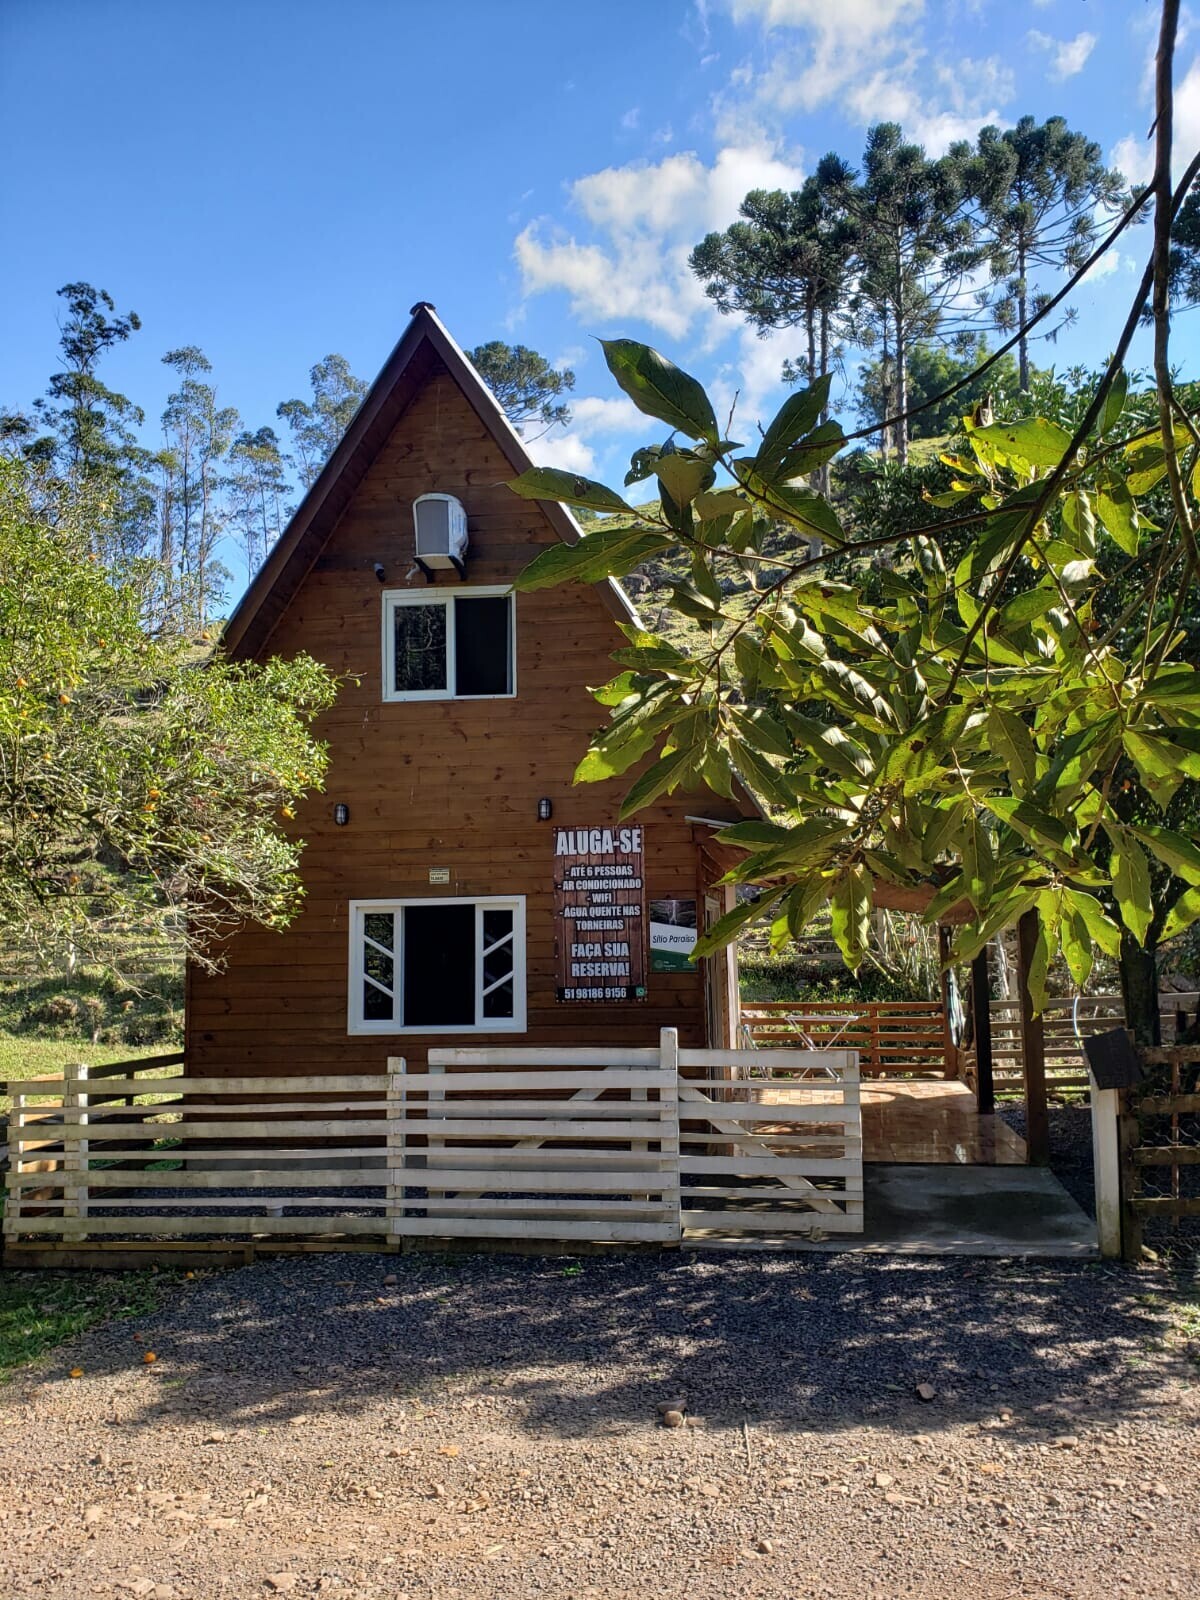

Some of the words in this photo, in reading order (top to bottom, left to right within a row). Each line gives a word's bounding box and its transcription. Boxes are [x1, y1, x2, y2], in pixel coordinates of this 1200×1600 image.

[556, 829, 641, 856] ALUGA-SE
[570, 865, 586, 877] ATÉ
[587, 866, 593, 876] 6
[595, 865, 633, 876] PESSOAS
[563, 880, 574, 890] AR
[576, 878, 641, 890] CONDICIONADO
[592, 893, 612, 903] WIFI
[564, 906, 588, 917] ÁGUA
[589, 906, 621, 917] QUENTE
[623, 906, 640, 916] NAS
[576, 920, 623, 930] TORNEIRAS
[572, 943, 602, 959] FAÇA
[604, 943, 629, 957] SUA
[572, 962, 630, 976] RESERVA!
[565, 989, 574, 999] 51
[576, 988, 603, 998] 98186
[605, 988, 626, 998] 9156
